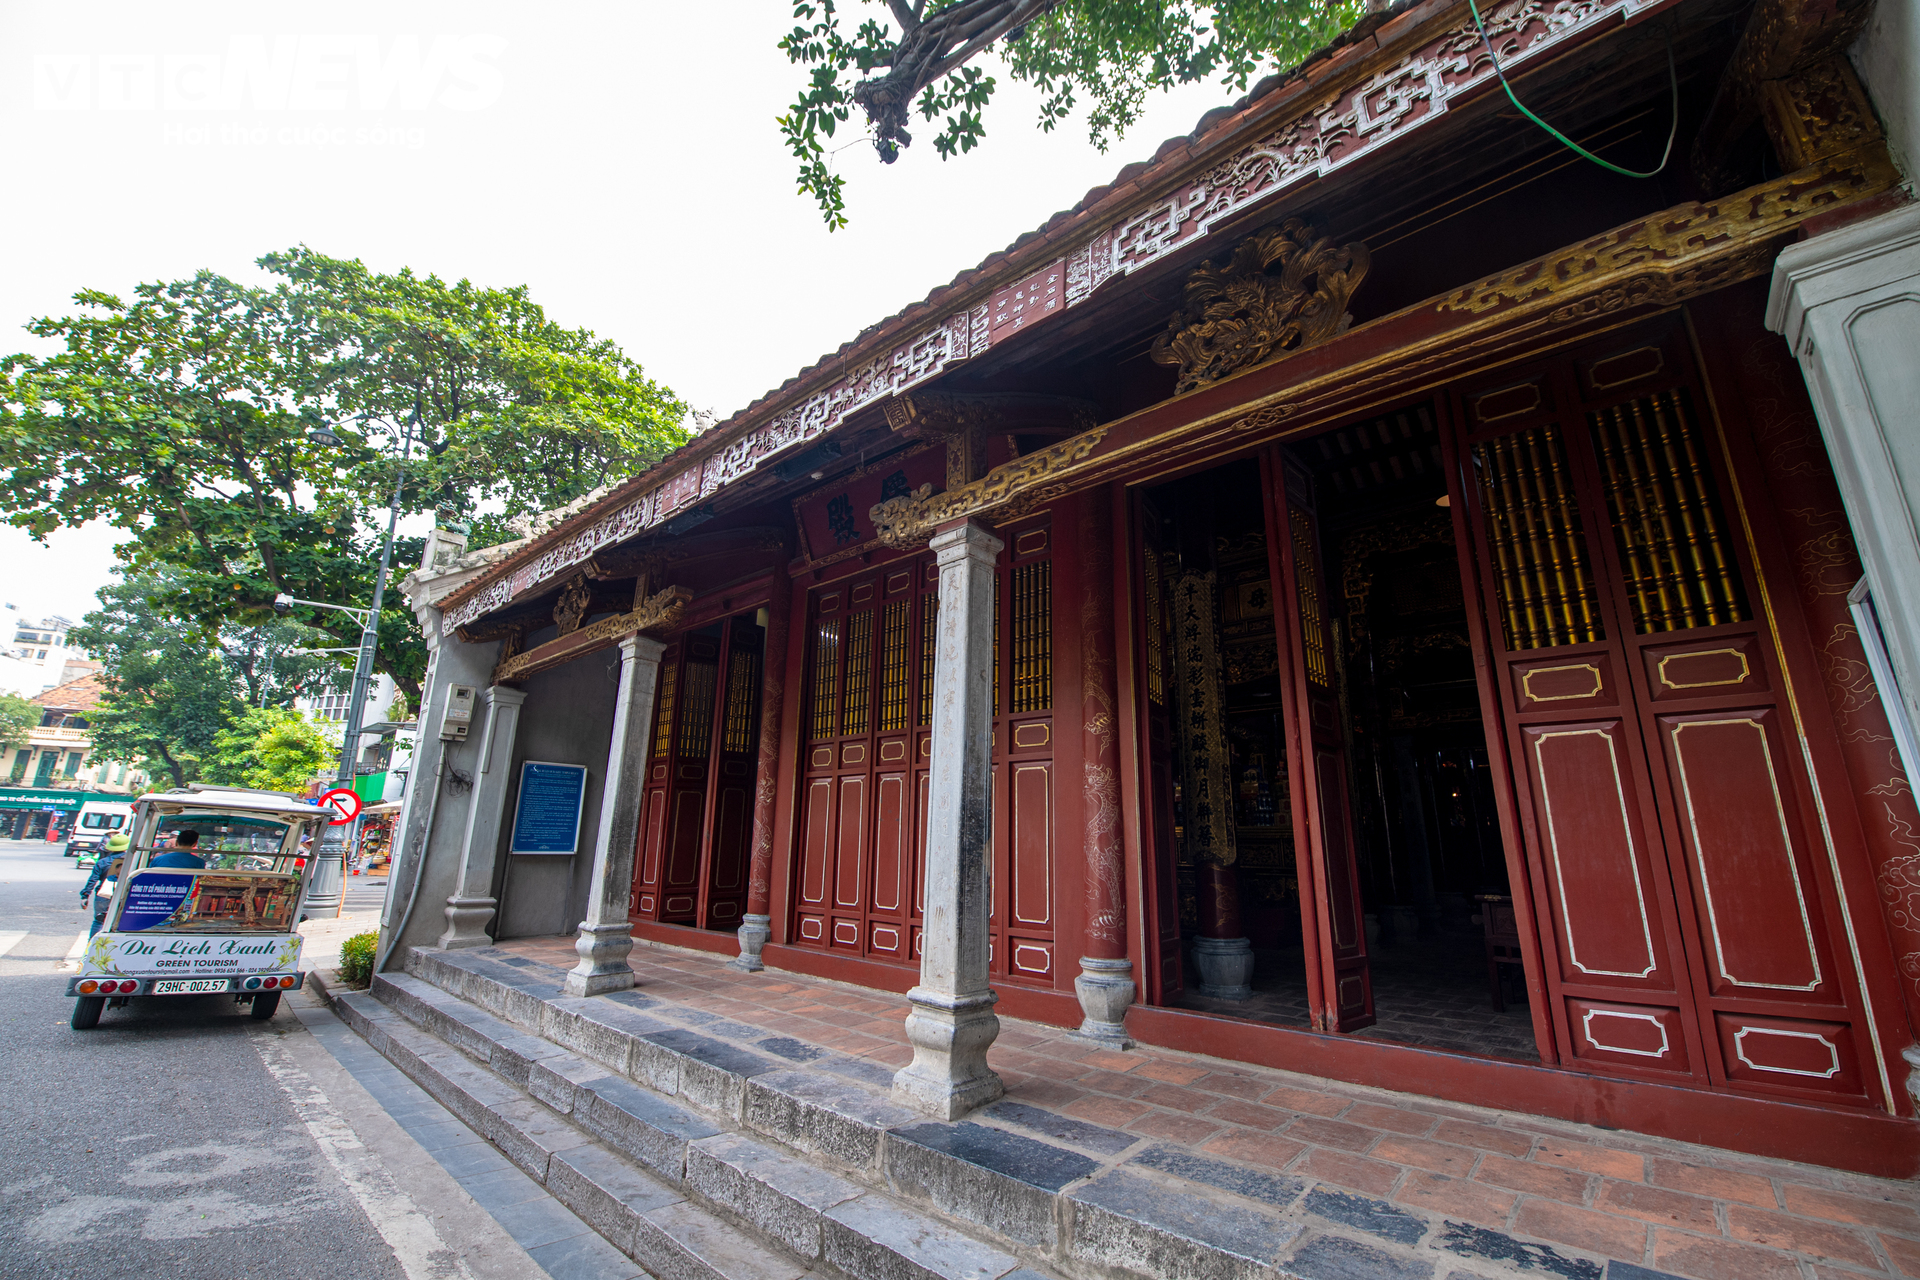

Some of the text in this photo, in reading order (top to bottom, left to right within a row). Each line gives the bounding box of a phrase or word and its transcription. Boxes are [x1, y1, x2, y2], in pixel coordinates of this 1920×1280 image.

[119, 939, 276, 958] Du Lịch Xanh
[156, 959, 239, 968] GREEN TOURISM
[157, 980, 226, 993] 29HC-002.57
